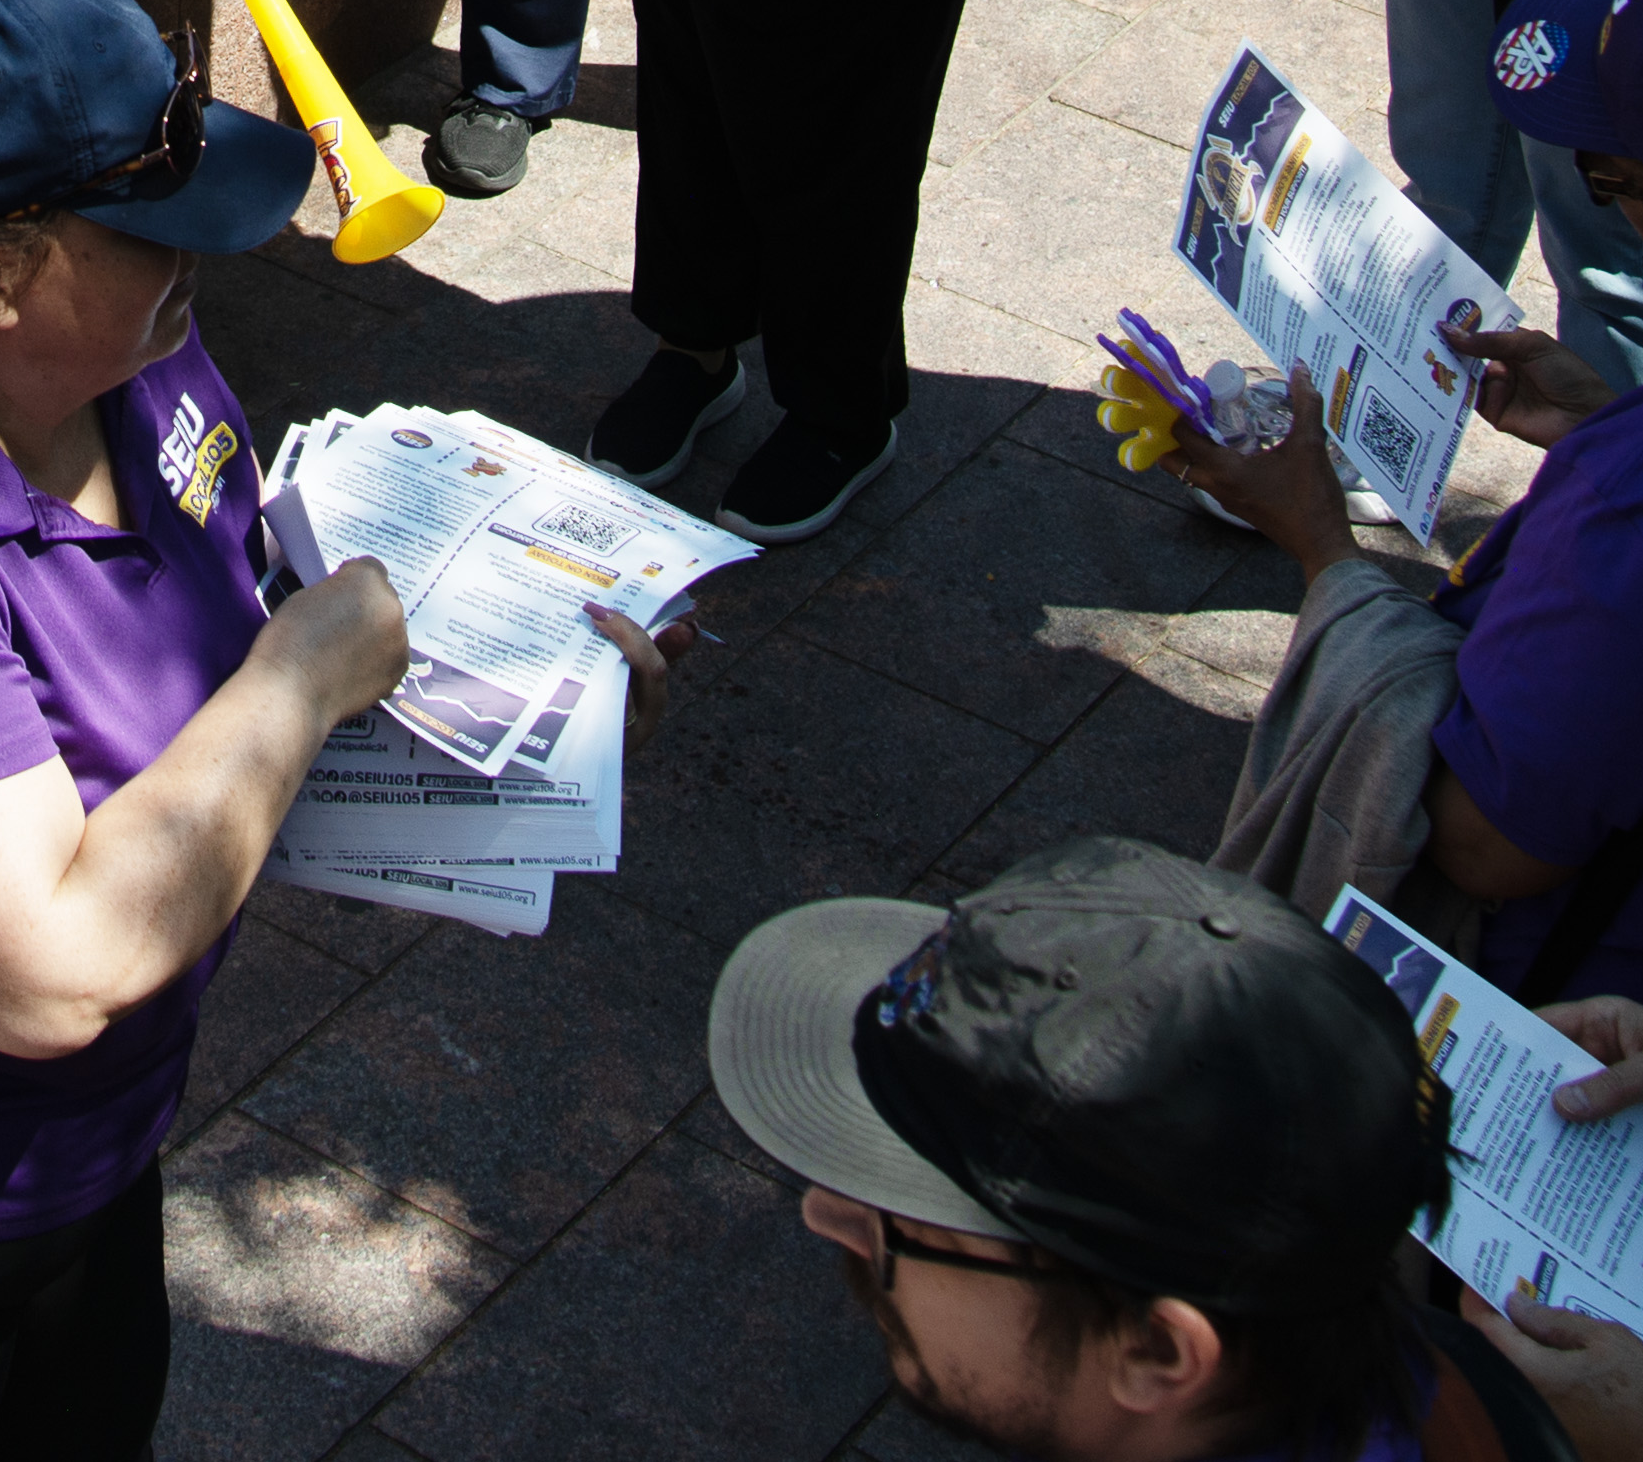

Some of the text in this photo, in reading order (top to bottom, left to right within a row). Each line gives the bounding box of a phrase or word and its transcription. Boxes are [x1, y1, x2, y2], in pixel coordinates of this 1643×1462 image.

[1216, 98, 1238, 128] SEIU
[158, 391, 205, 498] SEIU
[205, 431, 235, 469] 105
[491, 519, 535, 547] JANITORS
[527, 544, 611, 589] SIGN ON TODAY
[418, 711, 455, 736] LOCAL
[451, 728, 489, 755] SEIU
[338, 770, 413, 788] @SEIU105
[497, 781, 573, 796] www.seiu105.org
[518, 855, 594, 868] www.seiu105.org
[1420, 993, 1458, 1048] JANITORS
